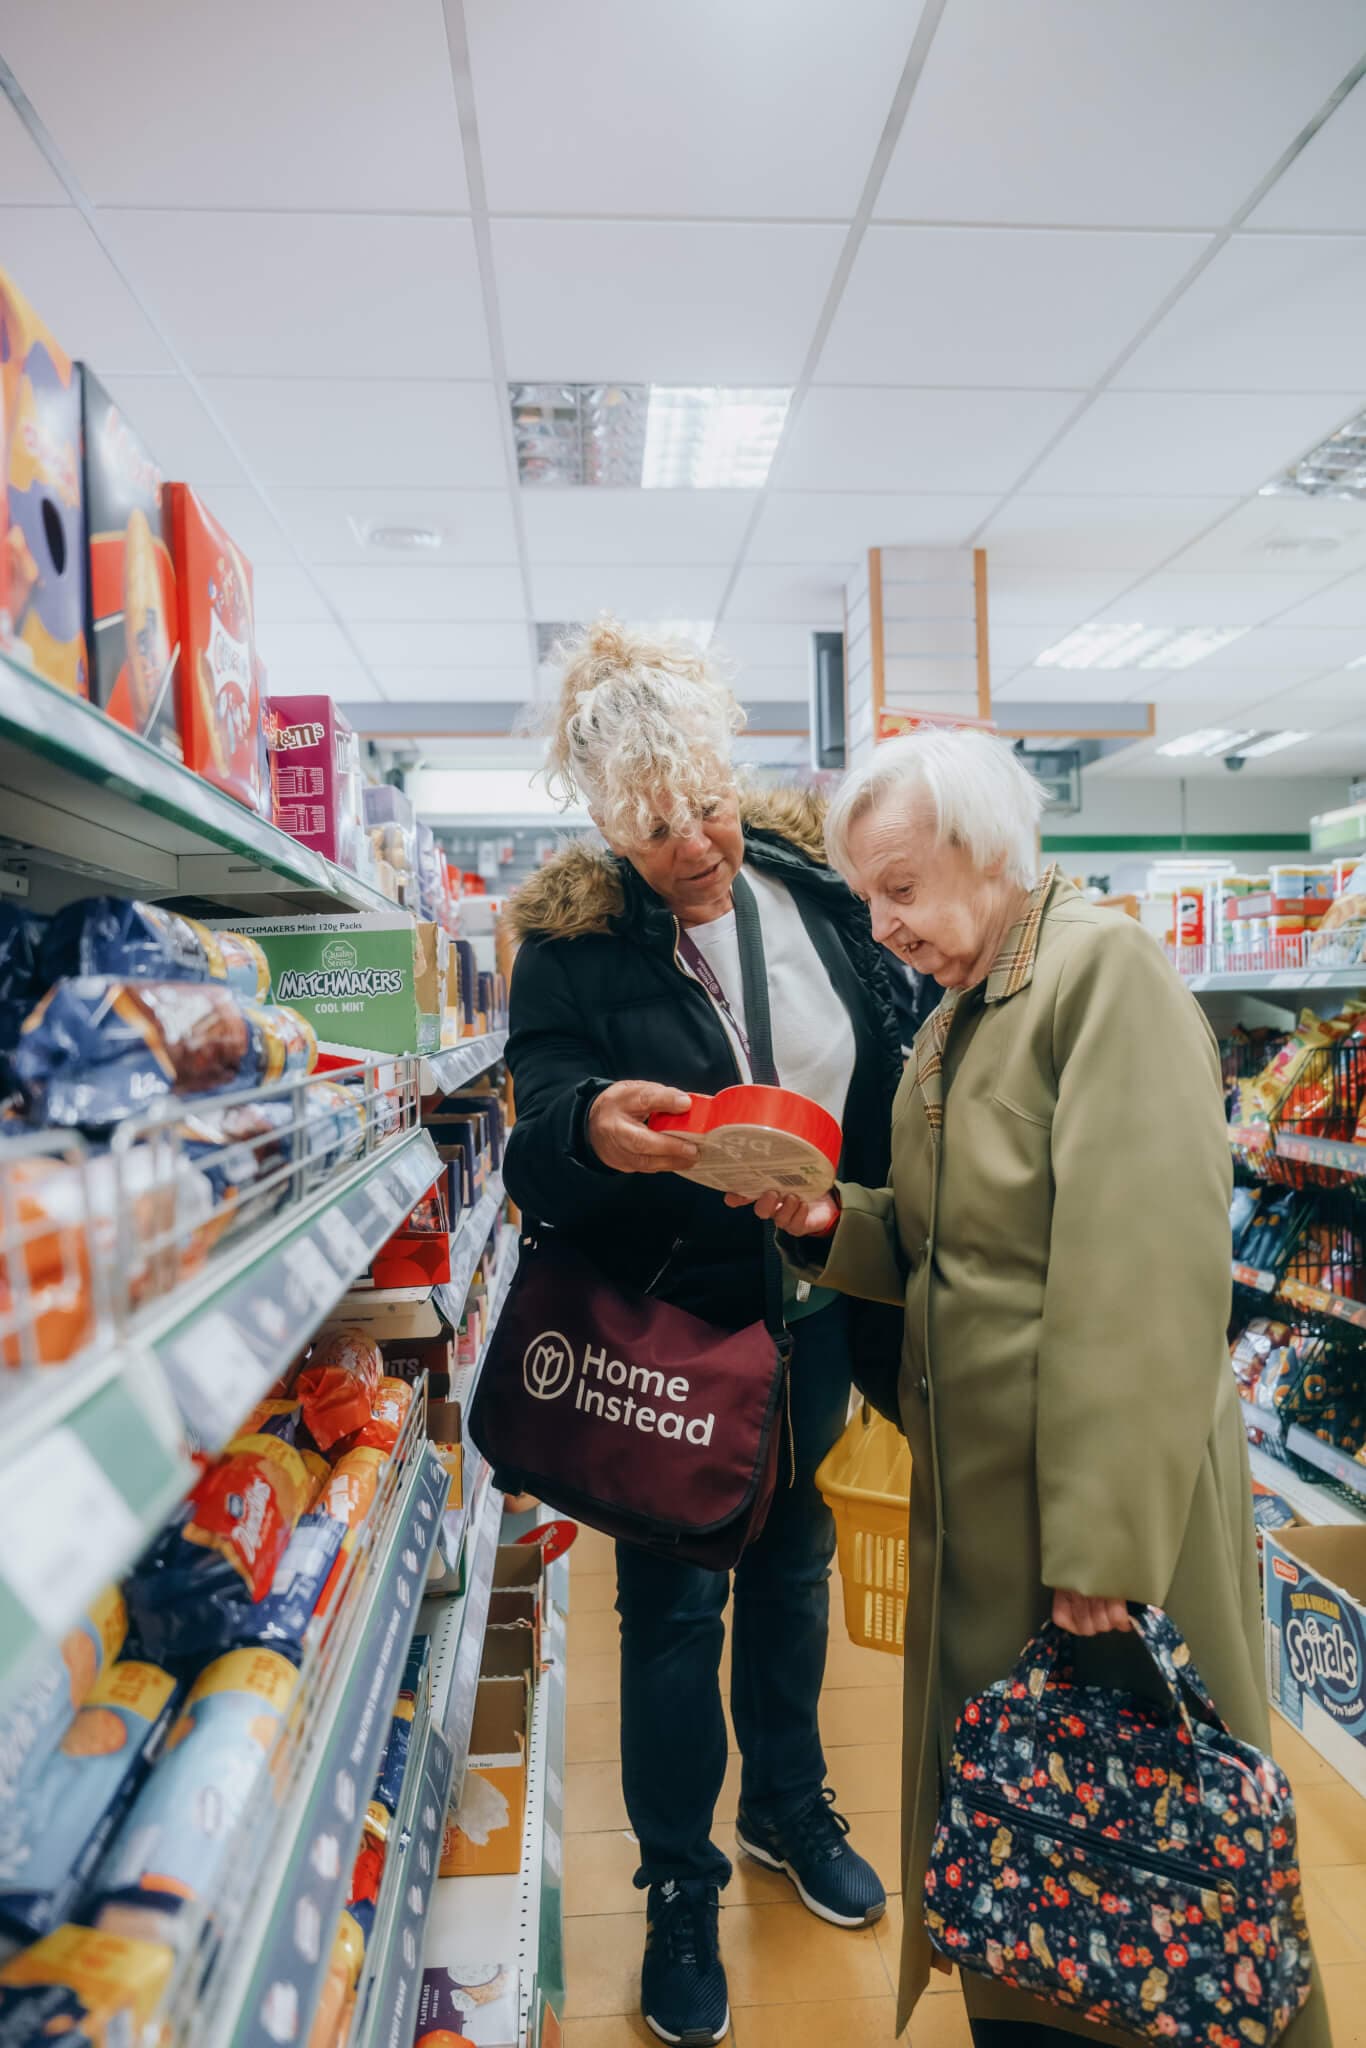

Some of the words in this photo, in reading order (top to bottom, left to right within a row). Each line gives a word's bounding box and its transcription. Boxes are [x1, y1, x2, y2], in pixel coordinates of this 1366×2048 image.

[297, 924, 316, 932] Mint
[319, 923, 338, 932] 120g
[340, 922, 362, 931] Packs
[279, 967, 403, 1000] MATCHMAKERS
[315, 1003, 338, 1014] COOL
[342, 1001, 365, 1013] MINT
[582, 1343, 689, 1402] Home
[575, 1378, 715, 1446] Instead
[1286, 1616, 1358, 1689] Spirals
